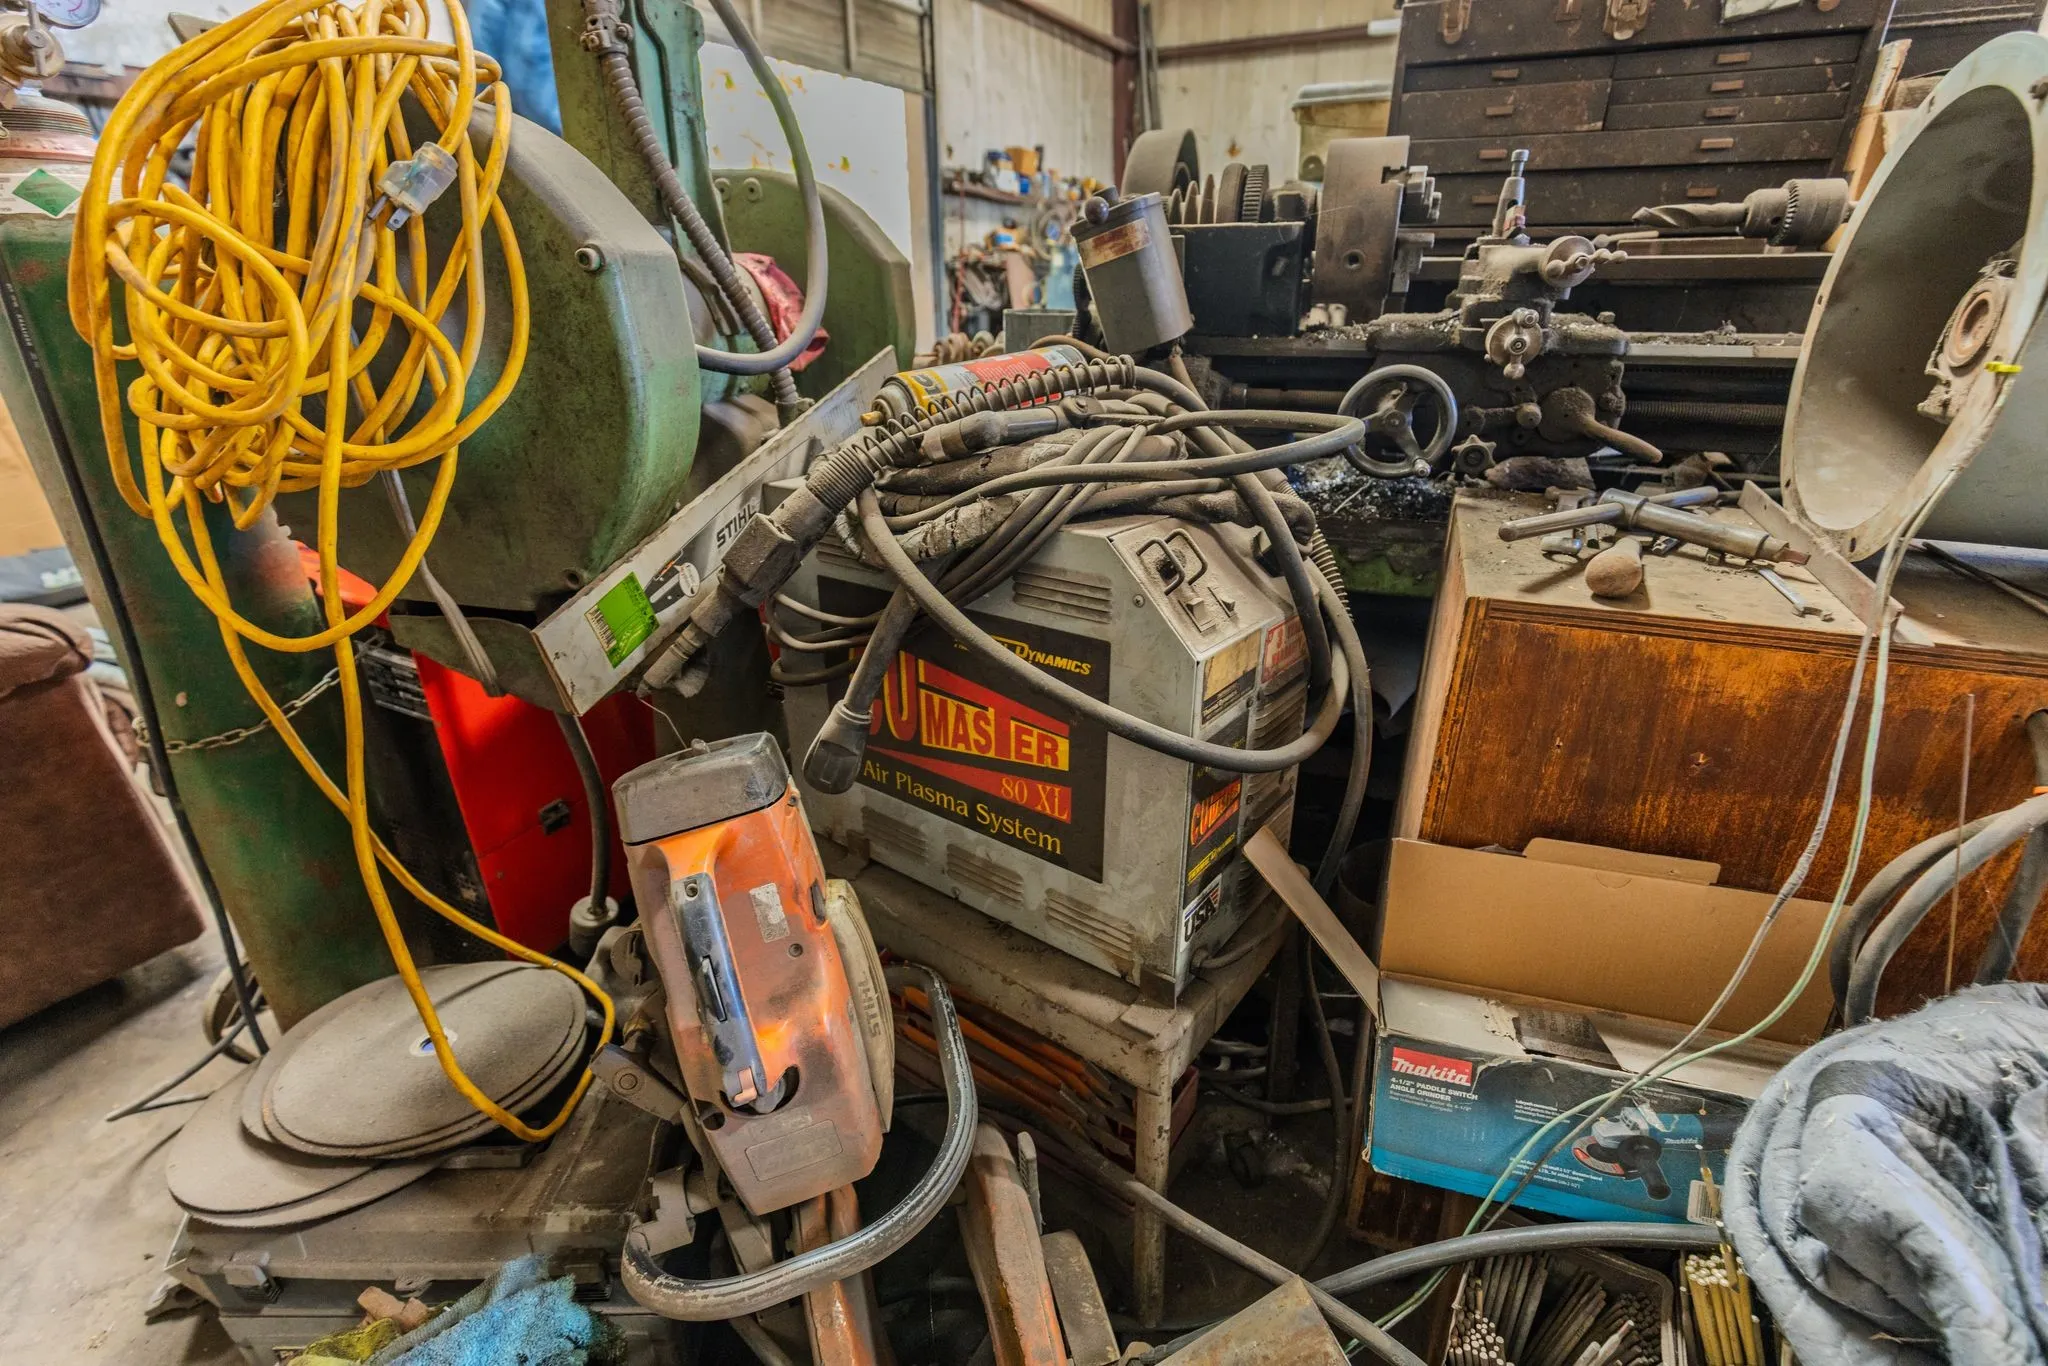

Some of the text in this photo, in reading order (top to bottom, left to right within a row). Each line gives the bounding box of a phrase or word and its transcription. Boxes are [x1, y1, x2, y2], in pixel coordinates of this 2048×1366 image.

[716, 504, 757, 549] STIHL
[864, 760, 1063, 855] Air Plasma System
[1000, 777, 1069, 819] 80 XL
[1184, 898, 1217, 943] USA
[1389, 1084, 1452, 1102] ANGLE GRINDER
[1416, 1082, 1447, 1094] PADDLE
[1447, 1088, 1479, 1101] SWITCH
